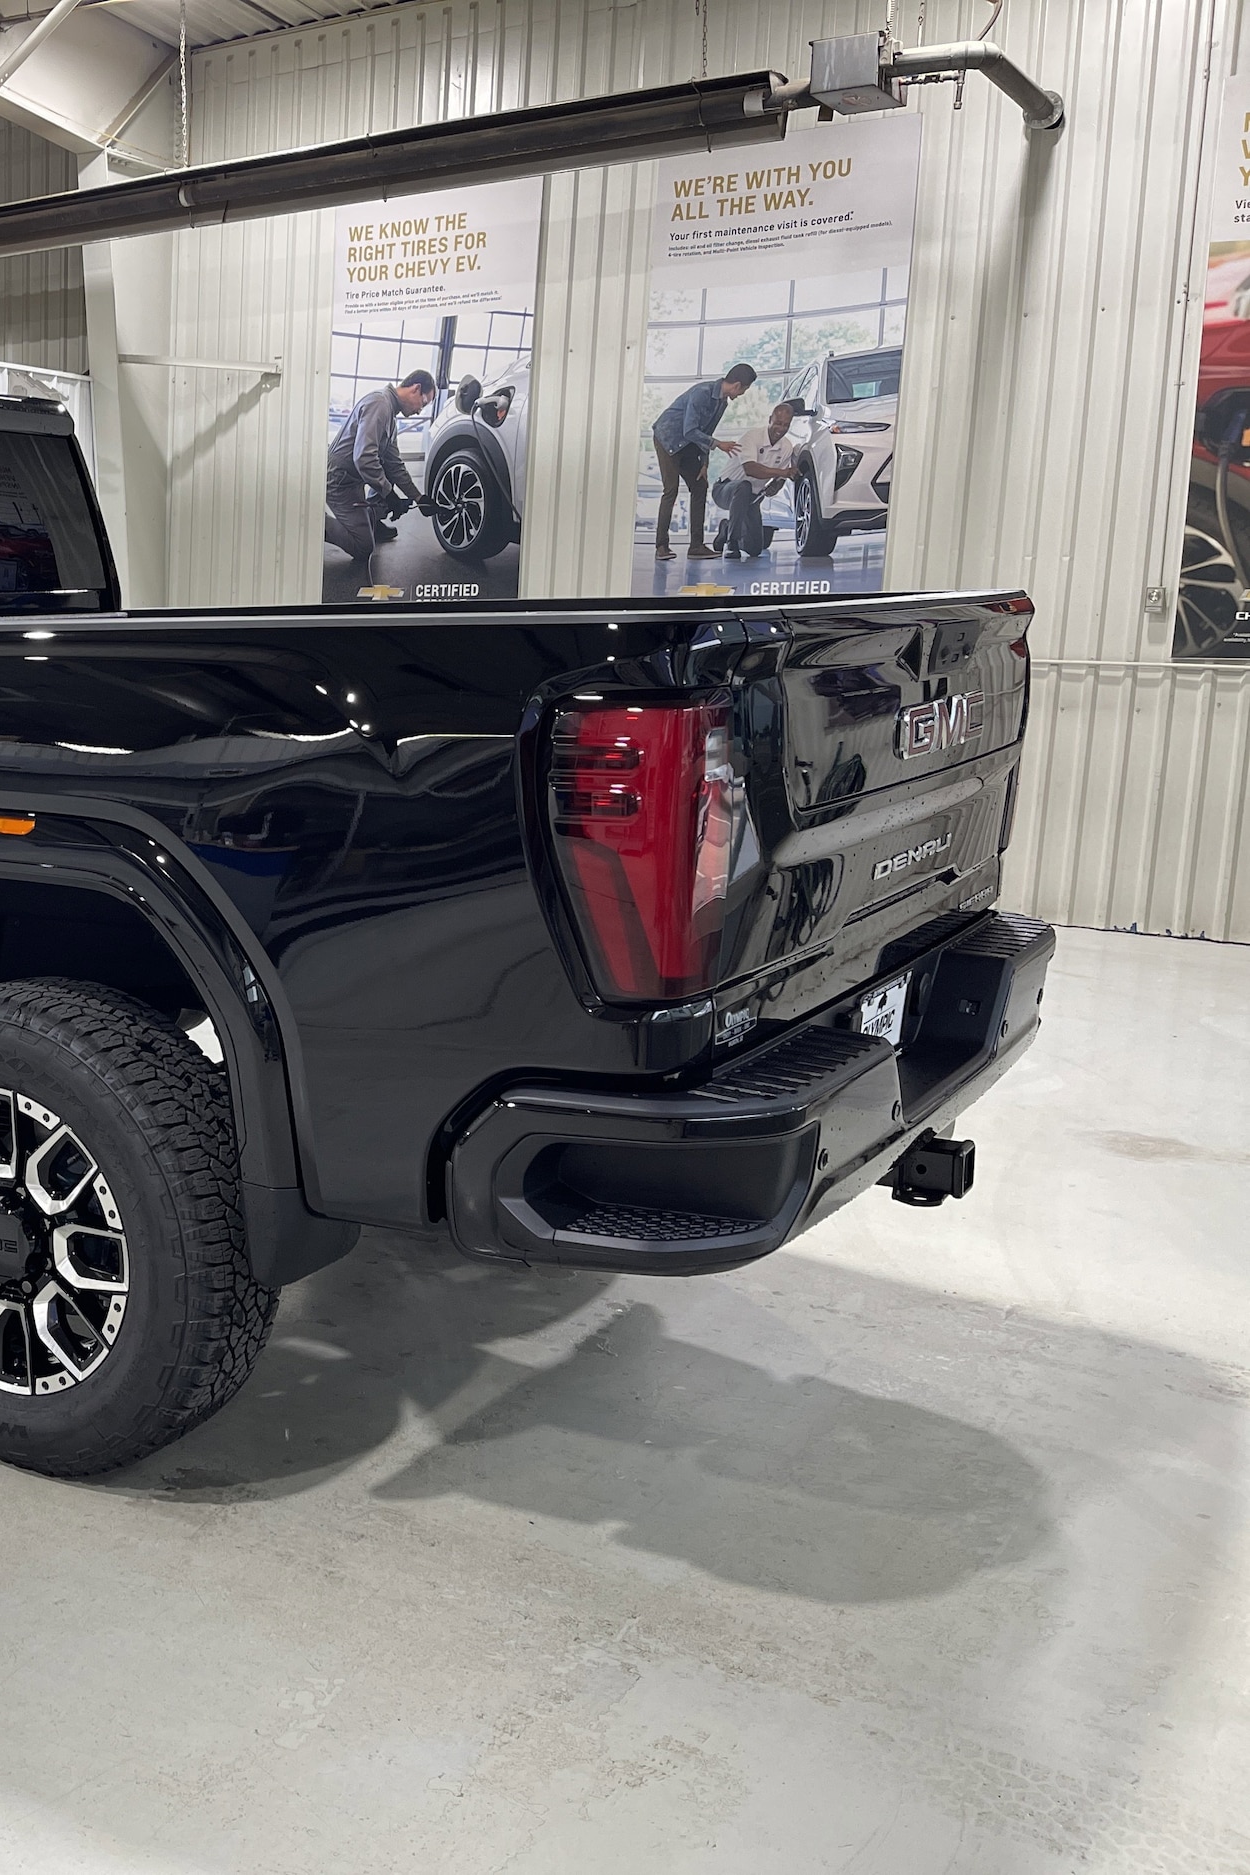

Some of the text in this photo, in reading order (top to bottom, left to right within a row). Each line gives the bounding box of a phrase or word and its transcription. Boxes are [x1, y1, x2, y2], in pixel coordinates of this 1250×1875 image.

[673, 157, 852, 198] WE'RE WITH YOU
[670, 187, 814, 222] ALL THE WAY.
[348, 212, 468, 242] WE KNOW THE
[670, 232, 690, 241] Your
[692, 230, 712, 240] first
[714, 223, 775, 237] maintenance
[777, 220, 798, 230] visit
[800, 218, 808, 227] is
[347, 232, 487, 263] RIGHT TIRES FOR
[346, 254, 481, 283] YOUR CHEVY EV.
[345, 285, 446, 300] Tire Price Match Guarantee.
[415, 584, 479, 597] CERTIFIED
[750, 580, 831, 595] CERTIFIED
[900, 690, 985, 760] GMC
[873, 832, 952, 880] DENALI
